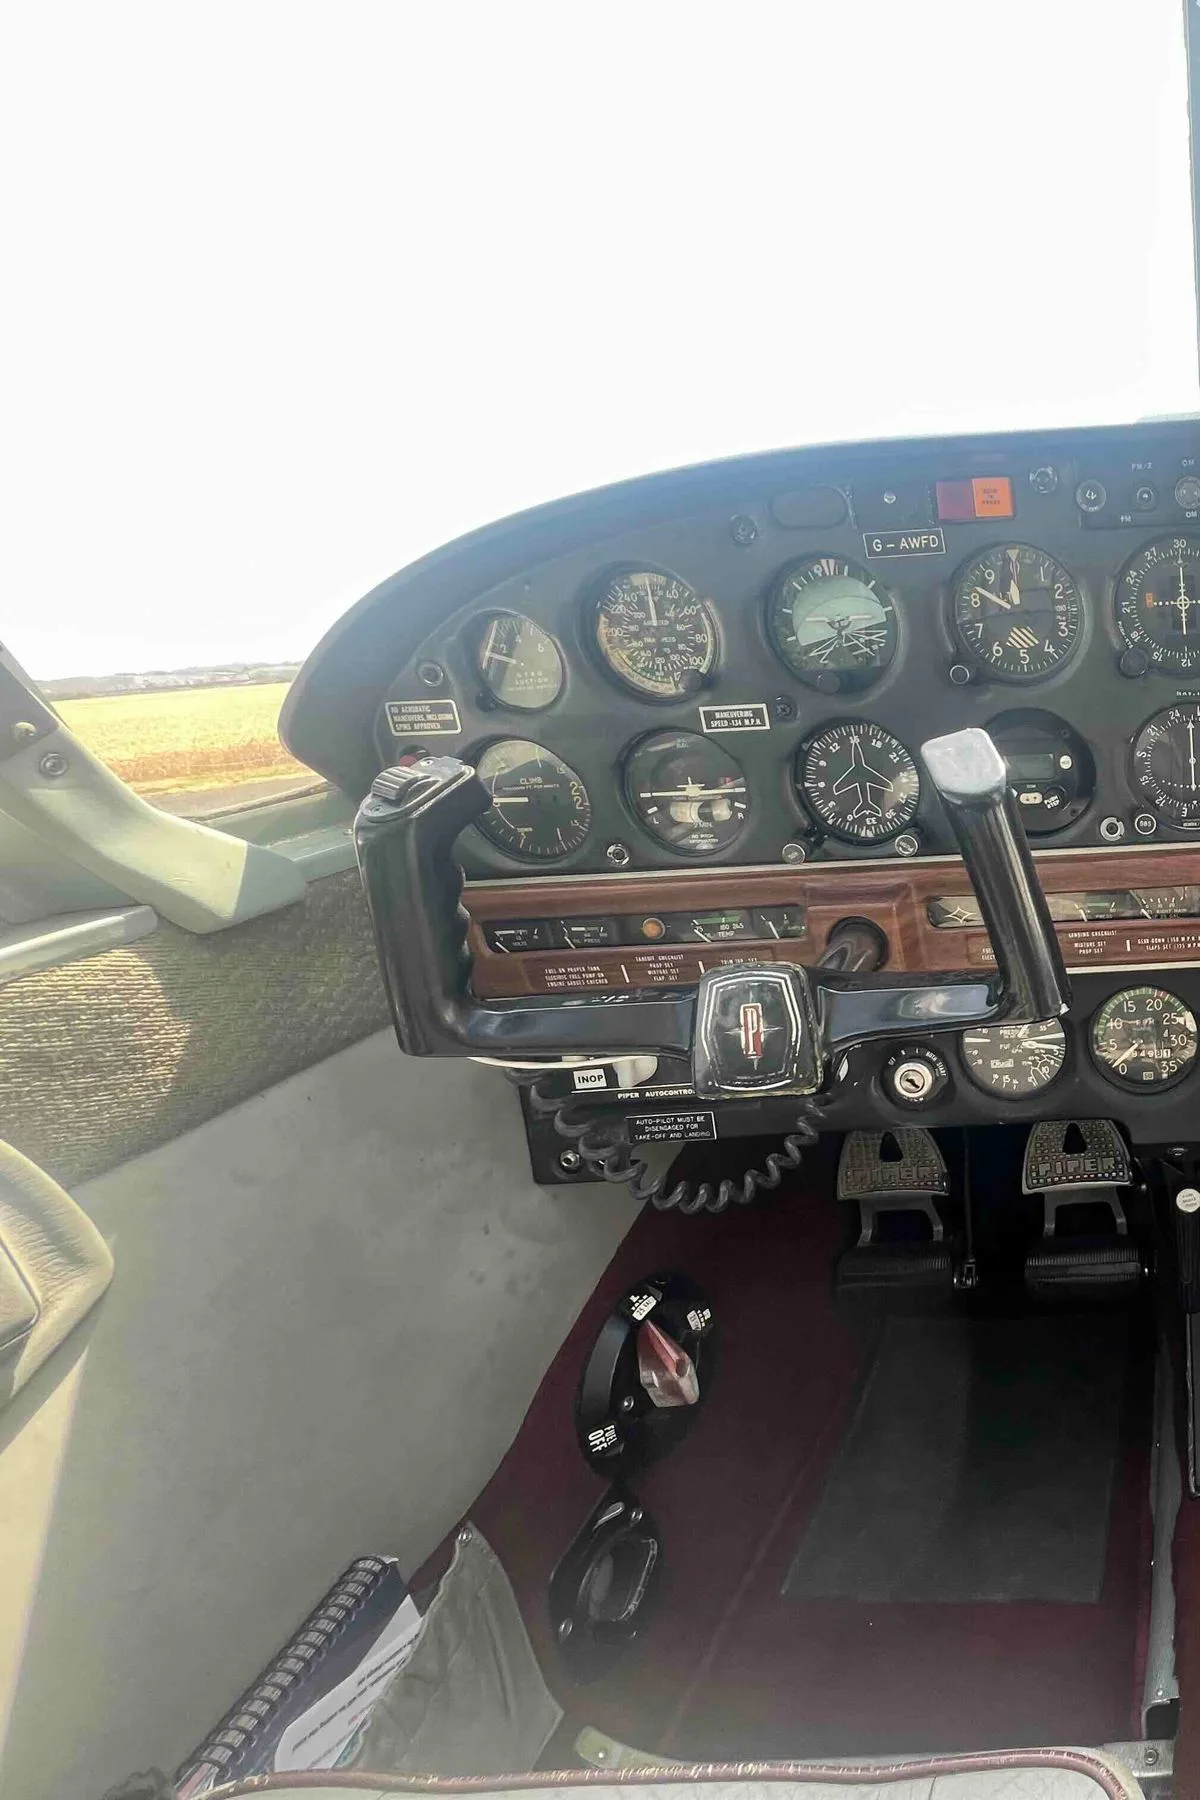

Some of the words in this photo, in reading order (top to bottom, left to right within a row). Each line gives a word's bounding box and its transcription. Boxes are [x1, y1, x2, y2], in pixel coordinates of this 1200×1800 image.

[984, 569, 995, 585] 9
[1040, 566, 1045, 582] 1
[666, 589, 679, 599] 40
[1054, 583, 1064, 599] 2
[970, 592, 981, 608] 8
[684, 605, 697, 616] 60
[974, 623, 984, 639] 7
[1058, 622, 1069, 637] 3
[992, 641, 1003, 657] 6
[1043, 639, 1056, 654] 4
[1020, 649, 1030, 664] 5
[715, 710, 753, 718] MANEUVERING
[520, 776, 544, 785] CLIMB
[652, 816, 660, 824] L
[737, 812, 745, 820] R
[718, 930, 735, 938] TEMP
[1123, 1001, 1137, 1013] 15
[1146, 998, 1163, 1011] 20
[1109, 1018, 1123, 1030] 10
[1162, 1013, 1179, 1025] 25
[1108, 1039, 1118, 1050] 5
[1170, 1034, 1187, 1046] 30
[936, 1061, 947, 1077] START
[1118, 1063, 1128, 1075] 0
[1161, 1060, 1178, 1073] 35
[577, 1074, 604, 1084] INOP
[635, 1117, 675, 1126] AUTO-PILOT
[644, 1124, 684, 1132] DISENGAGED
[634, 1133, 666, 1141] TAKE-OFF
[588, 1429, 608, 1453] OFF
[604, 1424, 618, 1446] FUEL
